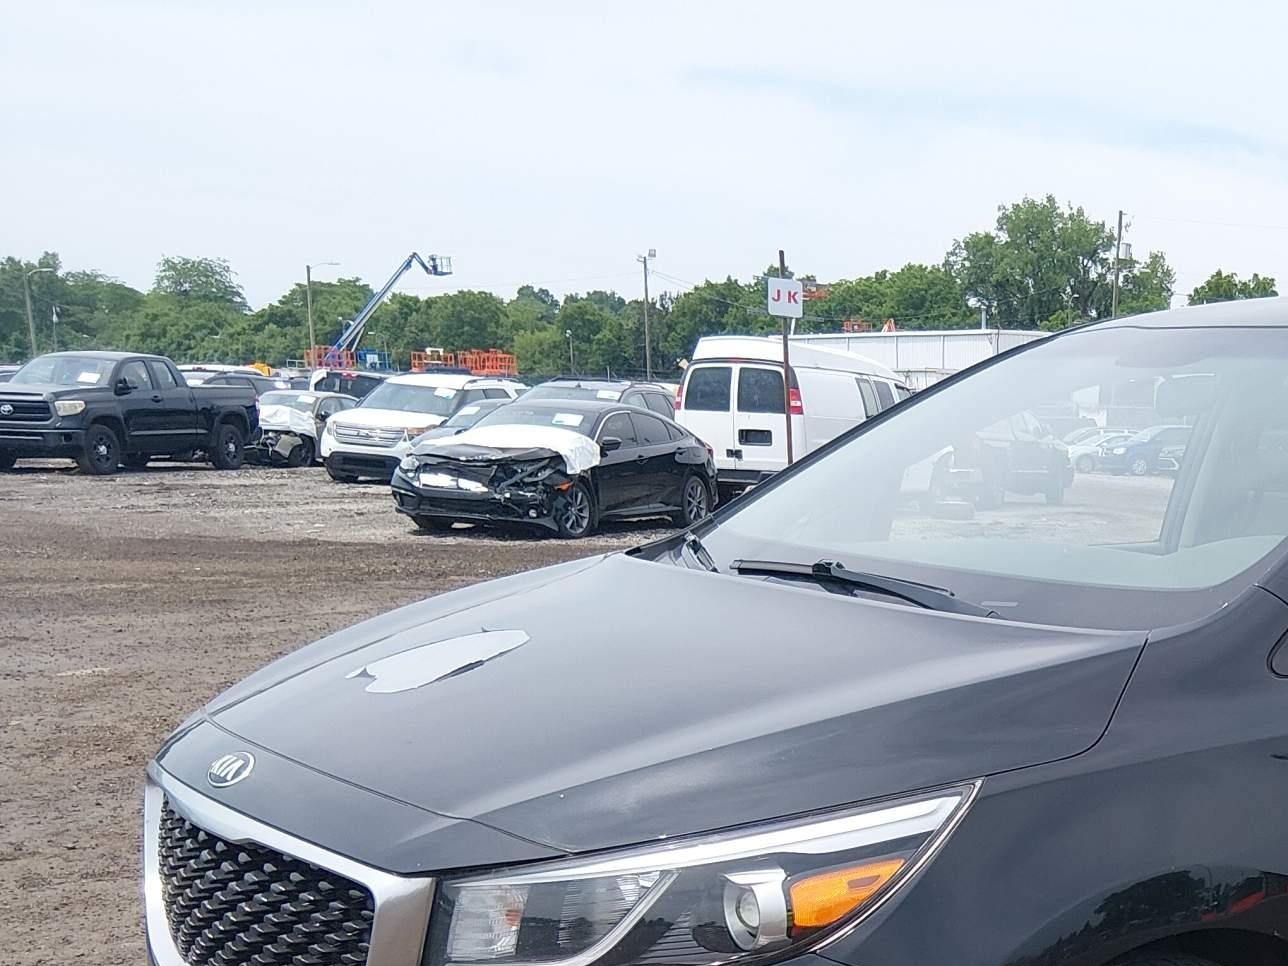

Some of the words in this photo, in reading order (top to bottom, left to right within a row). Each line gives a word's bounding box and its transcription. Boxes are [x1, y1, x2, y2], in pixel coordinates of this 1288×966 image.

[772, 289, 781, 302] J
[787, 290, 799, 305] K
[211, 754, 245, 781] KIA
